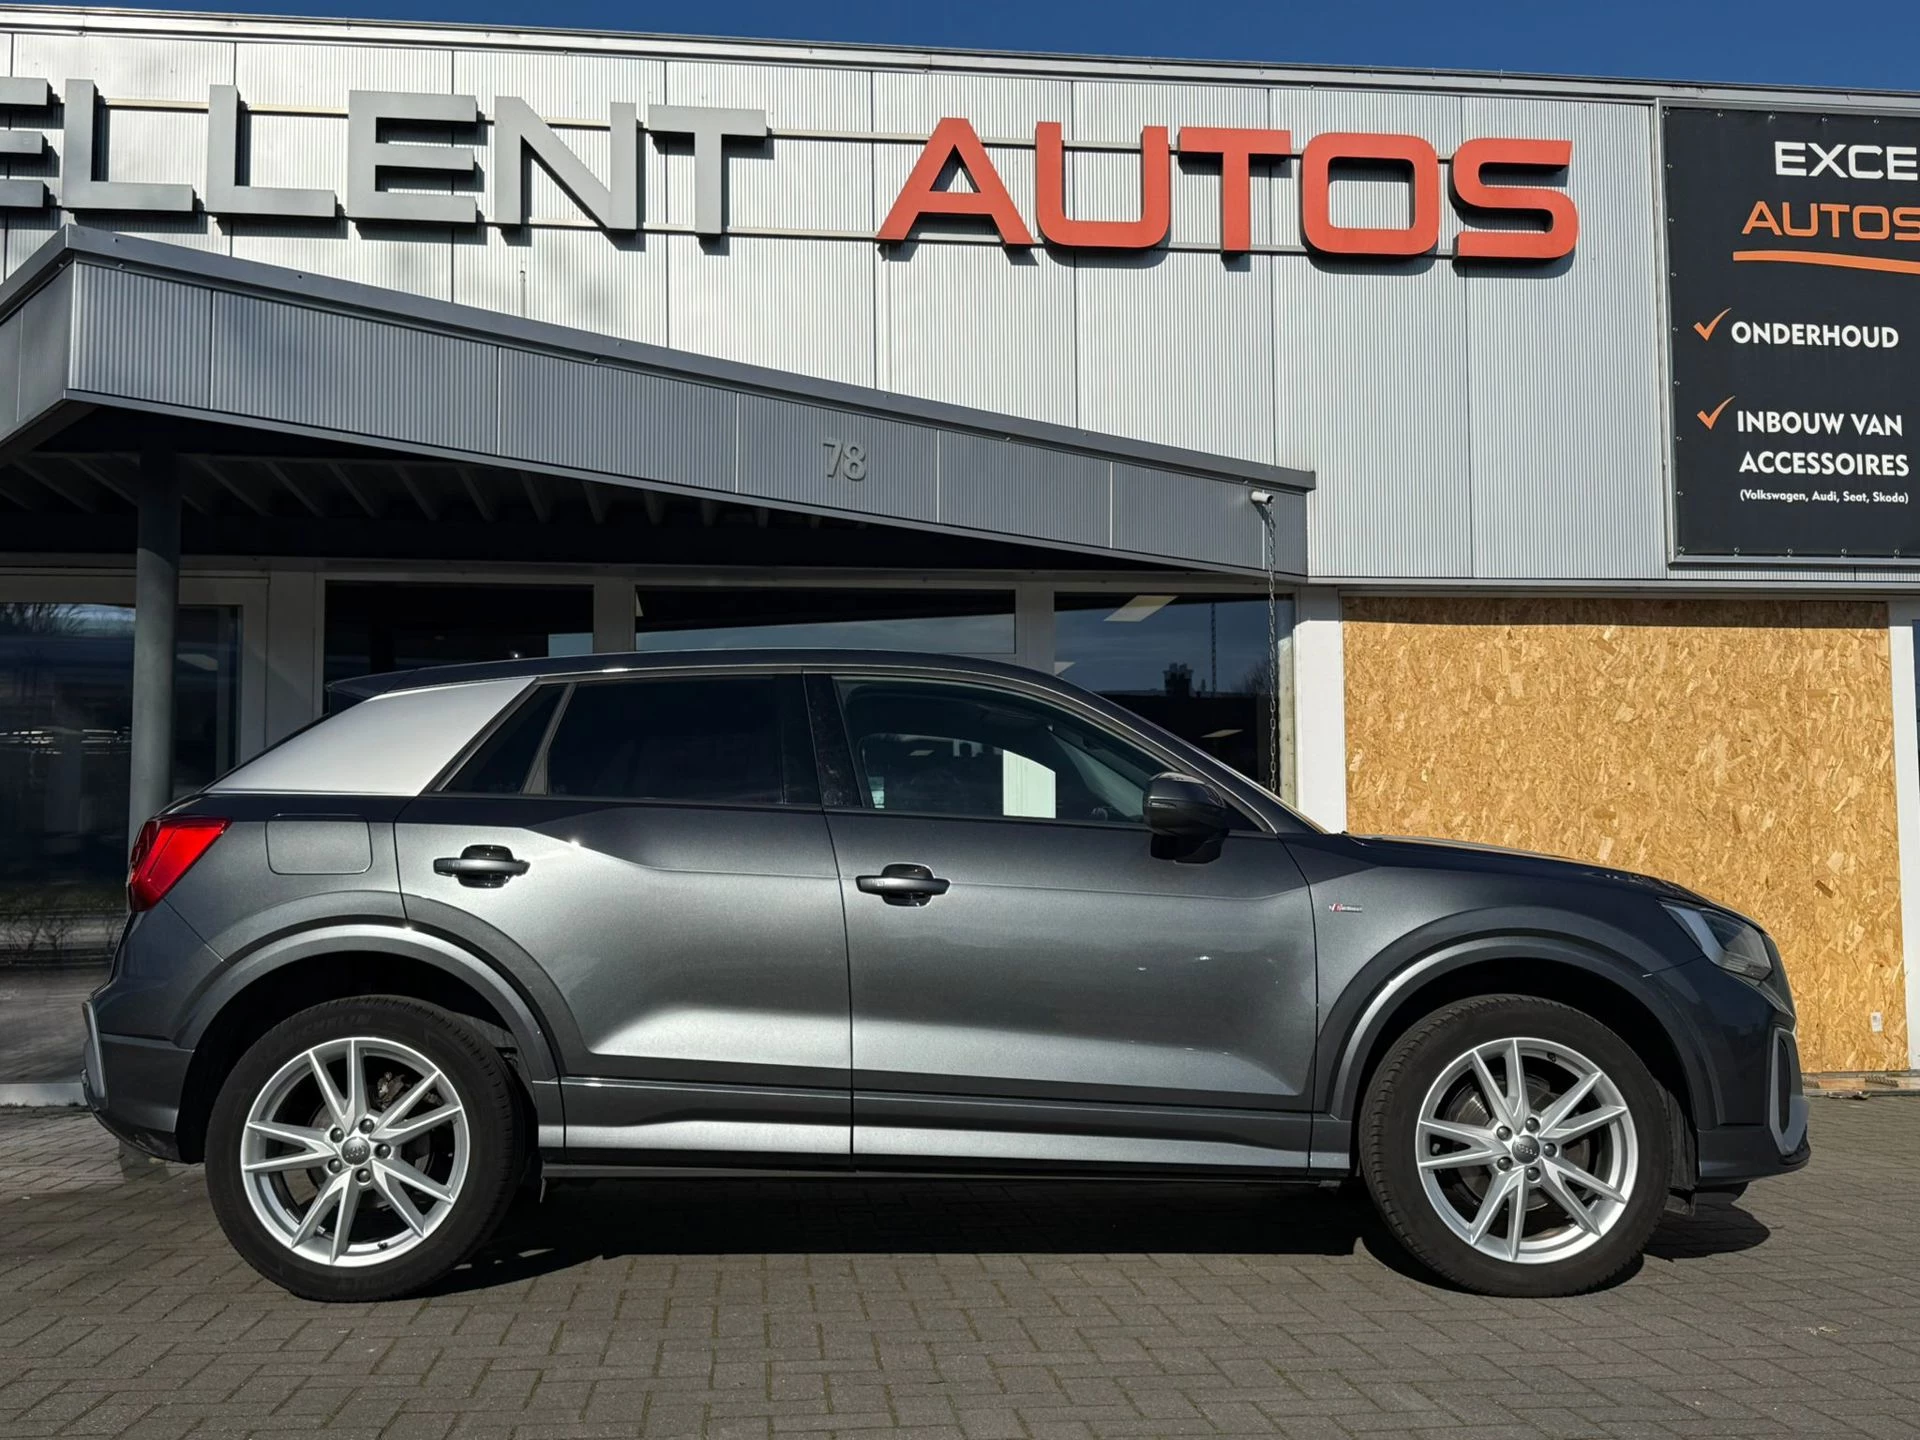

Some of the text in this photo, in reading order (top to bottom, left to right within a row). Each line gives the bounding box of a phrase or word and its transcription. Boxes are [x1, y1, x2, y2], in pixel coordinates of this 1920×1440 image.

[1774, 140, 1919, 181] EXCE
[876, 117, 1579, 259] AUTOS
[1741, 200, 1920, 241] AUTOS
[1731, 320, 1899, 348] ONDERHOUD
[1737, 410, 1903, 437] INBOUW VAN
[821, 438, 866, 481] 78
[1738, 451, 1910, 477] ACCESSOIRES
[1740, 488, 1909, 504] (Volkswagen, Audi, Seat, Skoda)
